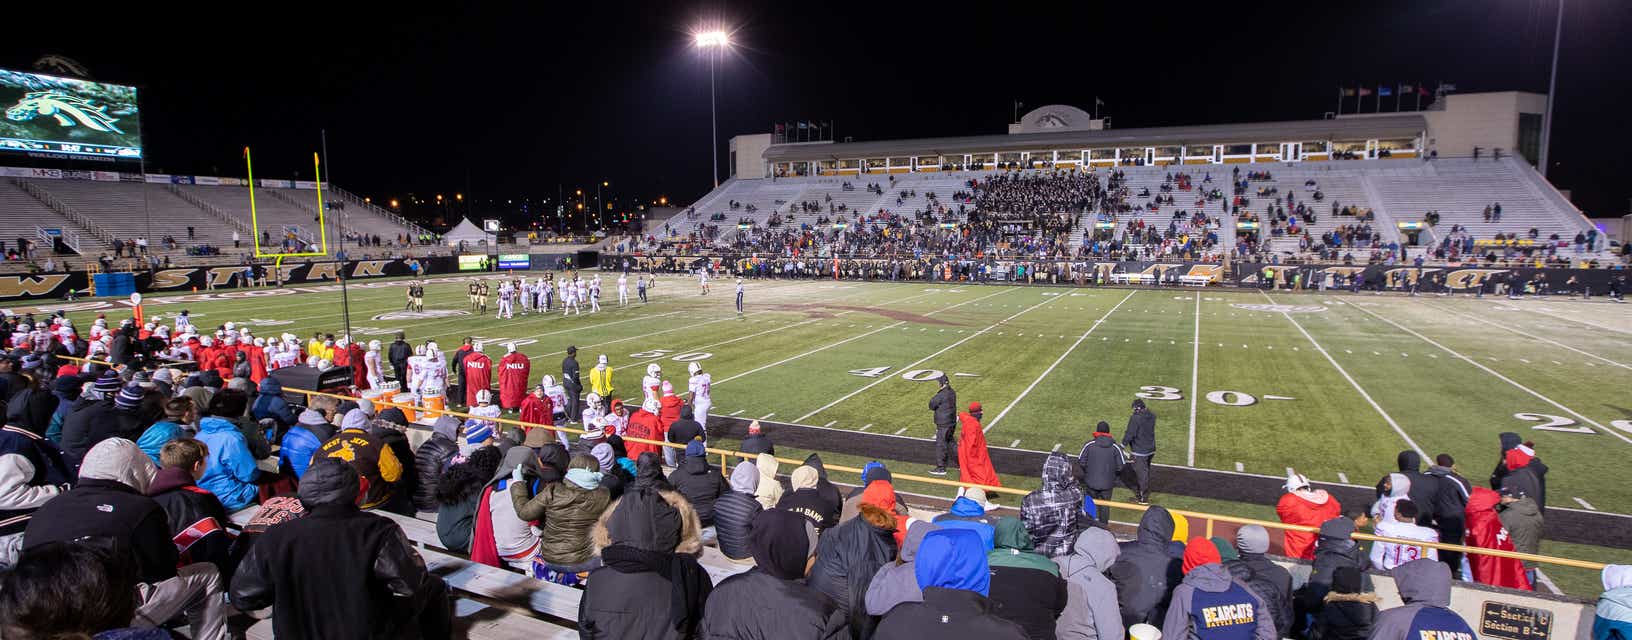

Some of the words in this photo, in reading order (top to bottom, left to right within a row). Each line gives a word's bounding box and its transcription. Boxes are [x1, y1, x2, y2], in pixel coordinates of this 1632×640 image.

[467, 360, 484, 369] NIU
[847, 366, 945, 382] 40
[1133, 384, 1258, 407] 30
[322, 438, 341, 451] WEST
[1394, 543, 1418, 567] 13
[1202, 603, 1254, 622] BEARCATS
[1501, 609, 1536, 623] Section
[1484, 620, 1519, 634] Section
[1522, 626, 1530, 635] B
